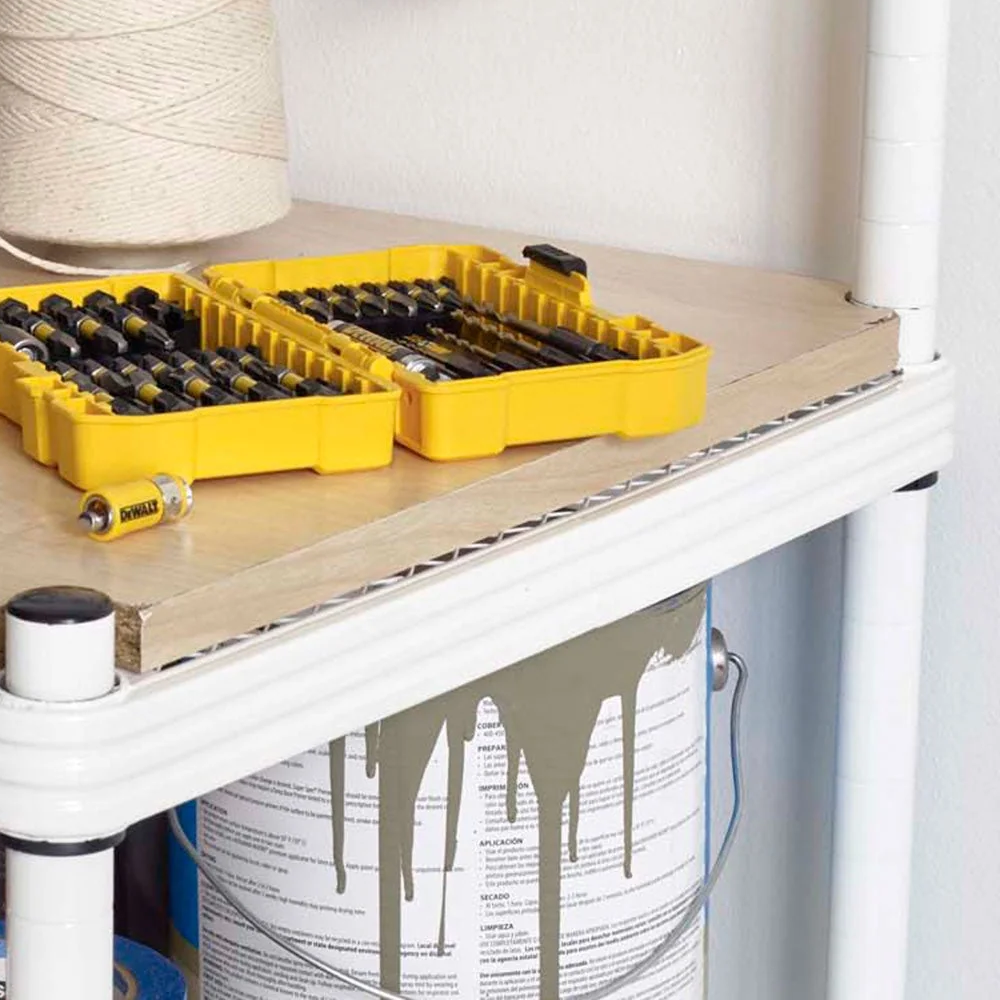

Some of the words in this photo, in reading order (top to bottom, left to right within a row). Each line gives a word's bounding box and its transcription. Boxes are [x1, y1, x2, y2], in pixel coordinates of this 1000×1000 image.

[479, 837, 524, 848] APLICACIÓN
[480, 892, 511, 901] SECADO
[480, 922, 515, 932] LIMPIEZA
